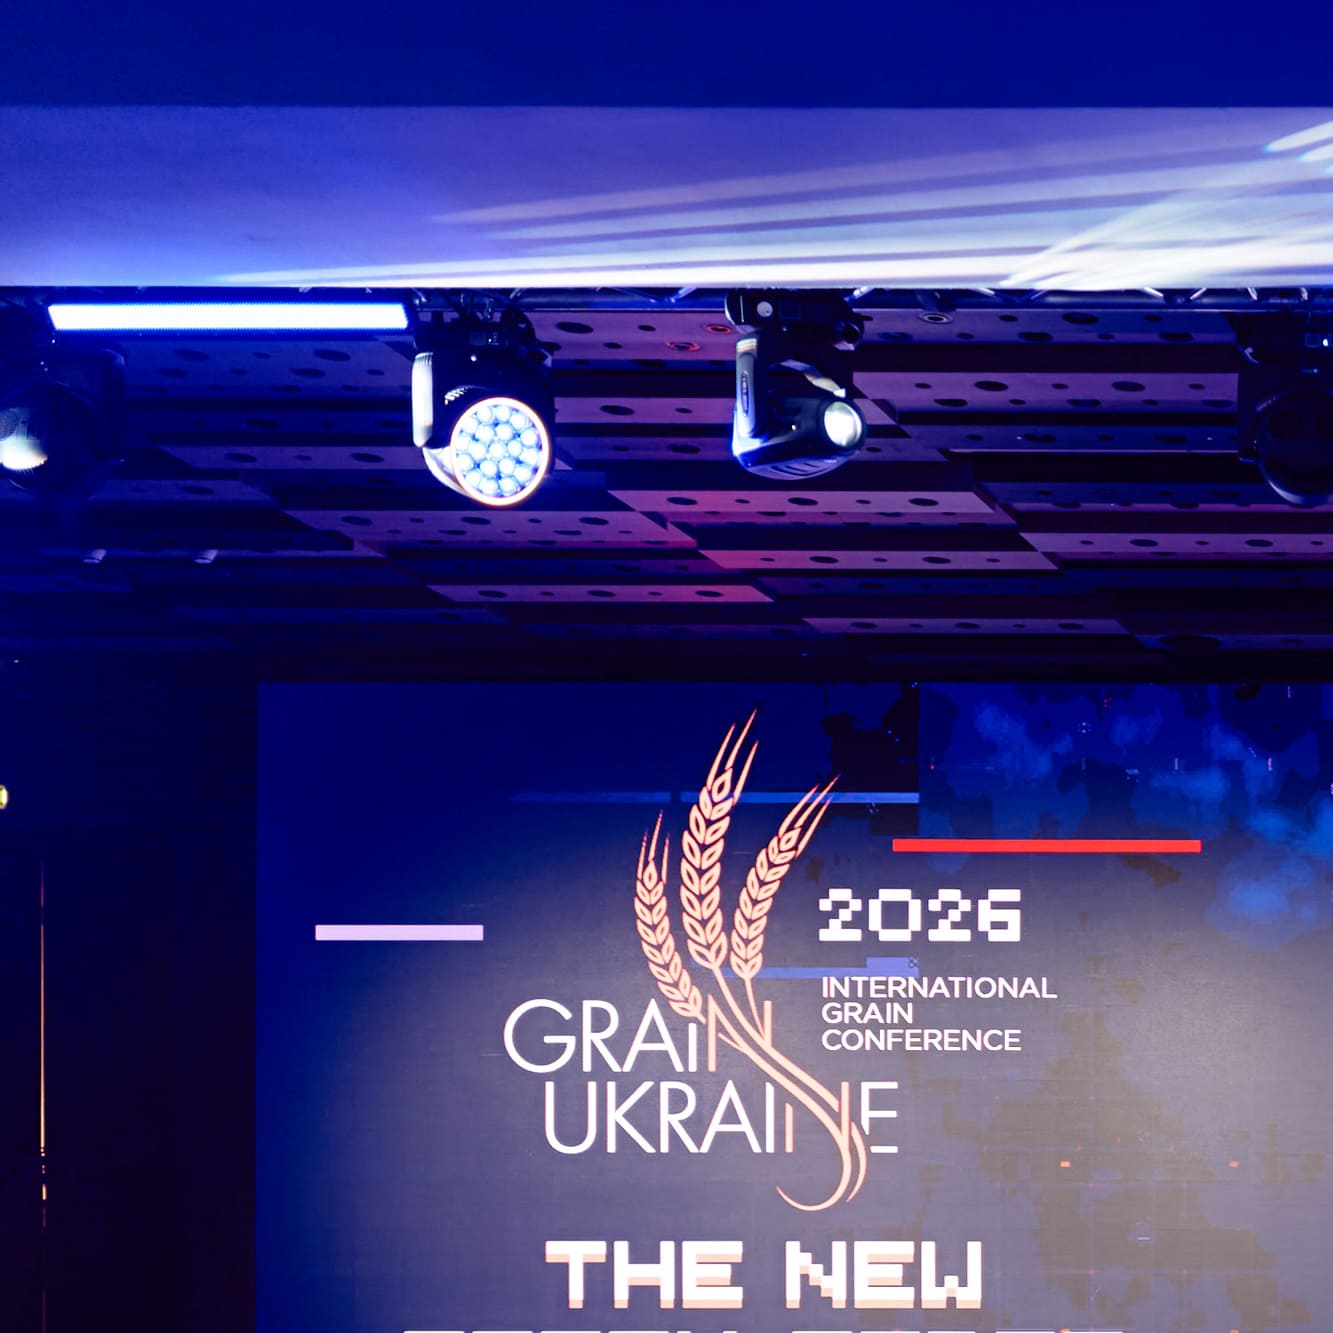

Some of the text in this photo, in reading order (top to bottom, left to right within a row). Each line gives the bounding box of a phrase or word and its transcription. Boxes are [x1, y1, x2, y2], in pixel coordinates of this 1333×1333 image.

[819, 888, 1022, 942] 2026
[821, 976, 1058, 999] INTERNATIONAL
[821, 1002, 914, 1025] GRAIN
[821, 1028, 1022, 1052] CONFERENCE
[544, 1080, 899, 1155] UKRAINE
[545, 1241, 982, 1309] THE NEW
